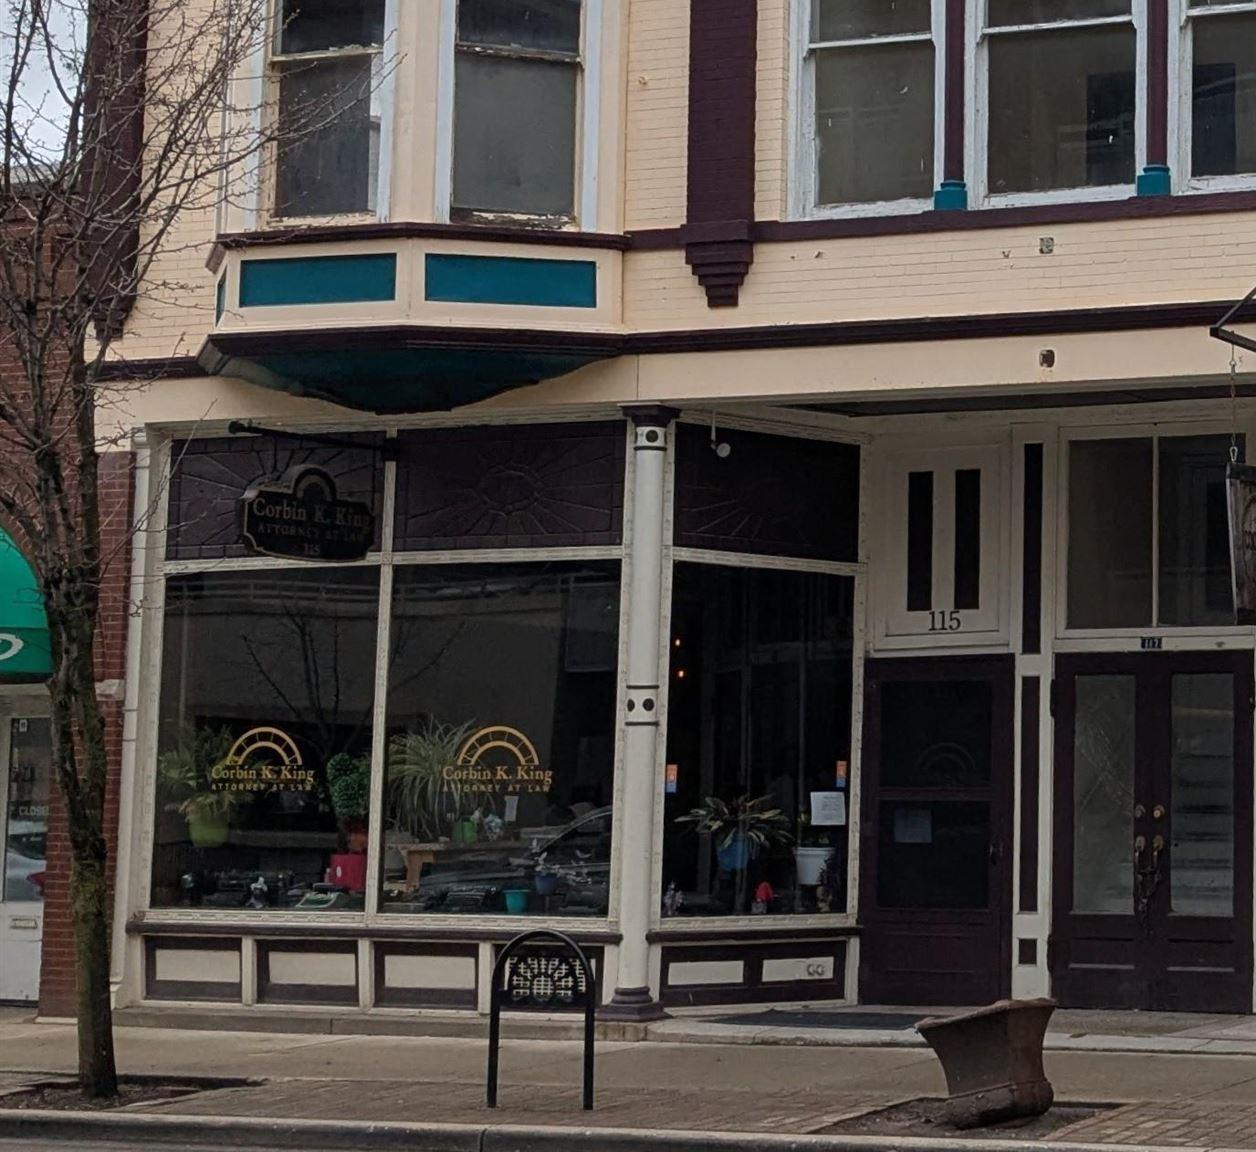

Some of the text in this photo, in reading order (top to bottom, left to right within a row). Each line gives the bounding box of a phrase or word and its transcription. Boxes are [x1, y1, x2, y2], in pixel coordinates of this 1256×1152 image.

[252, 497, 307, 522] Corbin
[928, 610, 962, 632] 115
[211, 765, 257, 780] Corbin
[281, 765, 316, 784] King
[442, 766, 553, 785] Corbin K. King
[211, 783, 266, 791] ATTORNEY
[291, 783, 313, 791] LAW
[442, 784, 551, 793] ATTORNEY AT LAW
[18, 805, 50, 817] CLOSE
